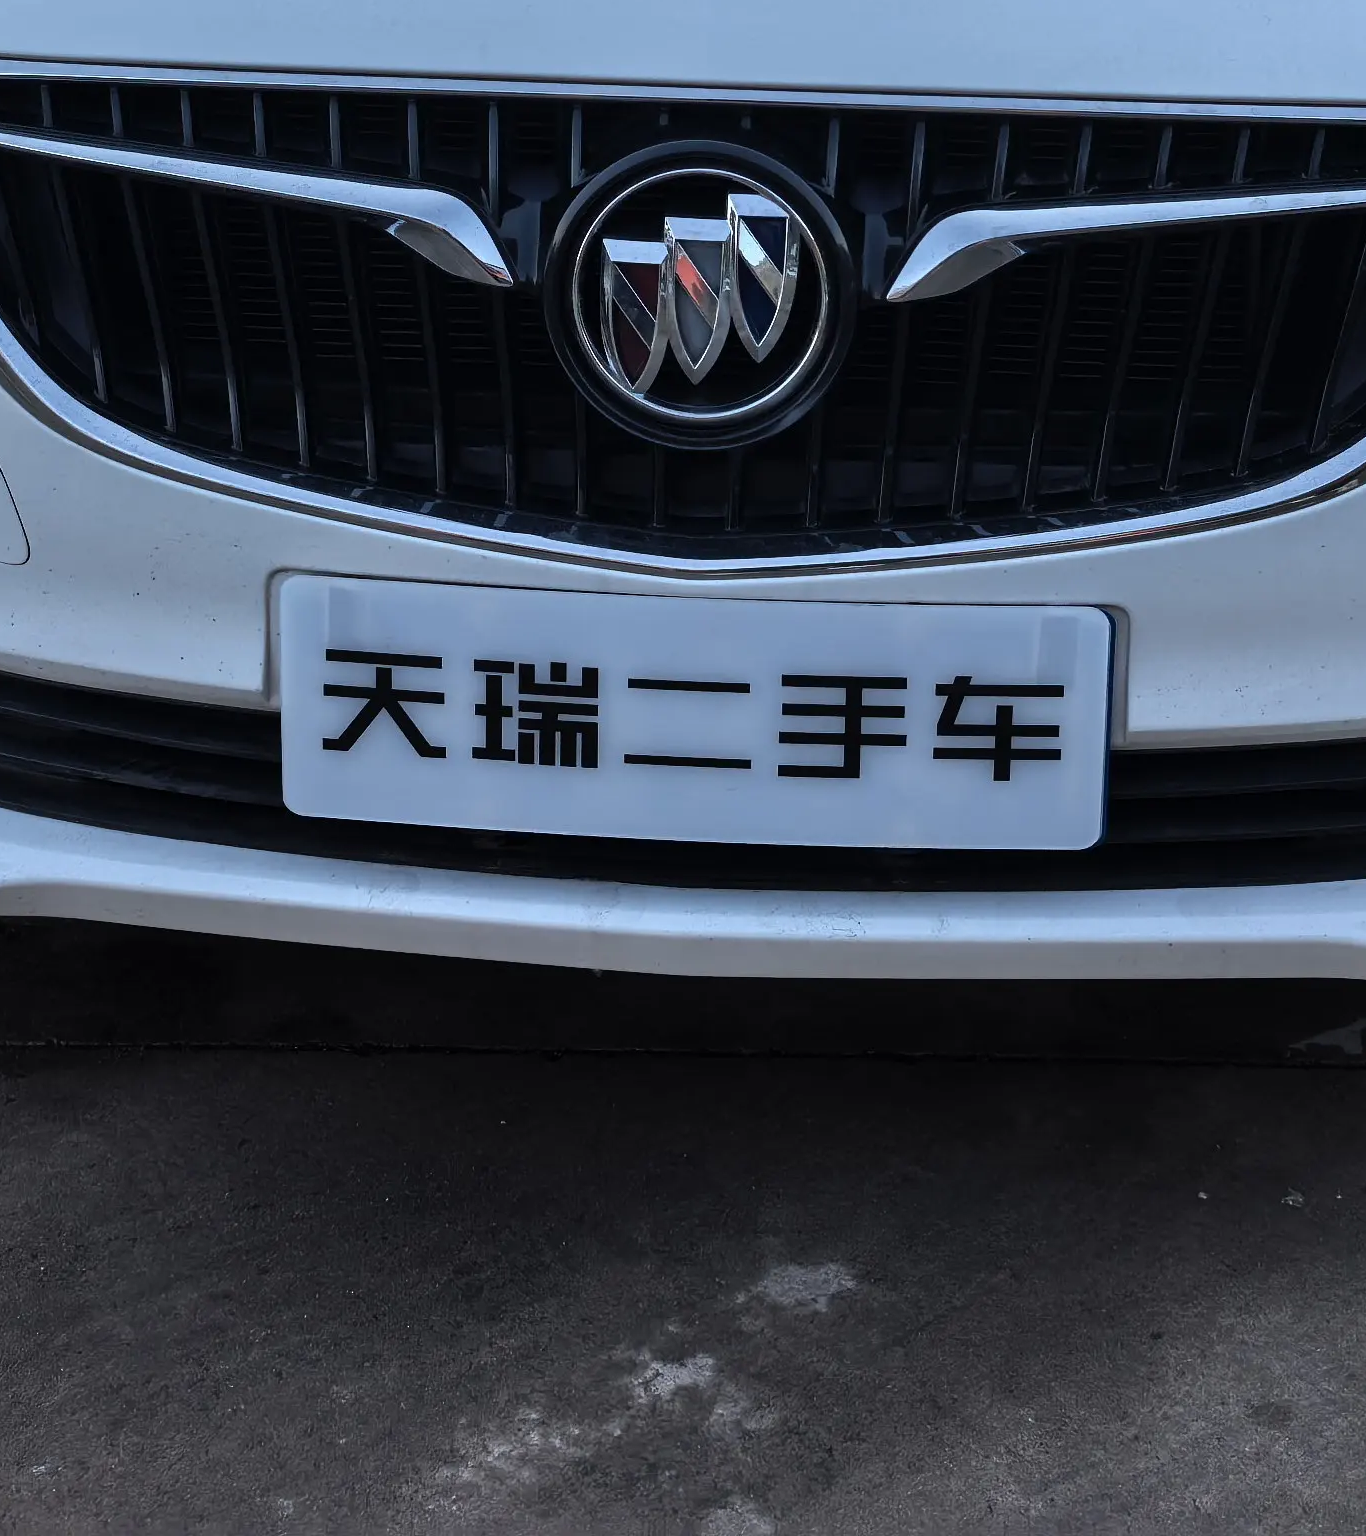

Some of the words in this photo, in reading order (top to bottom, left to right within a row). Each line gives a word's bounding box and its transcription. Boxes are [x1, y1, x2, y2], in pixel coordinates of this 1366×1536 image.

[322, 648, 1066, 781] 天瑞二手车
